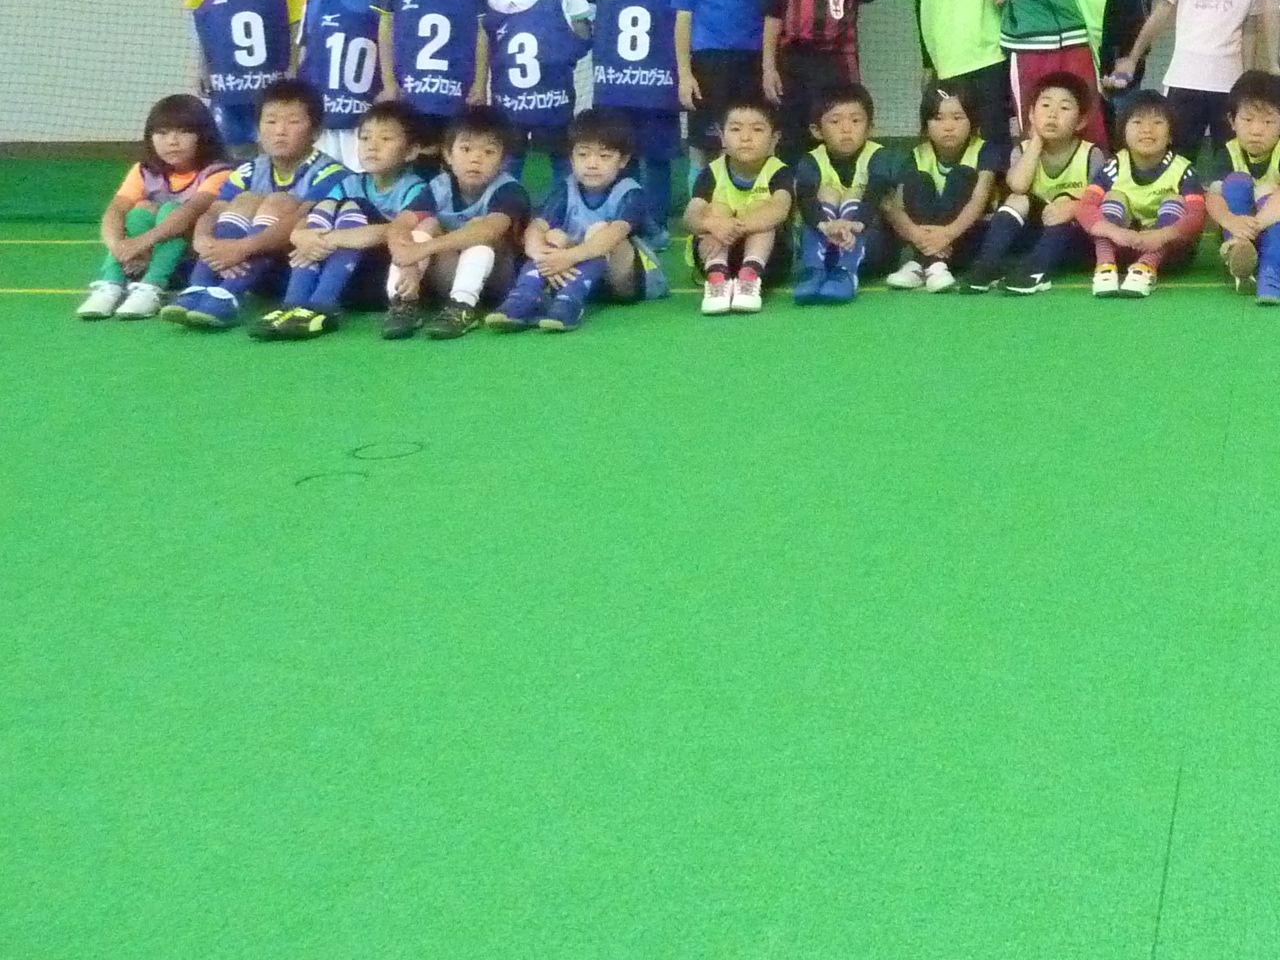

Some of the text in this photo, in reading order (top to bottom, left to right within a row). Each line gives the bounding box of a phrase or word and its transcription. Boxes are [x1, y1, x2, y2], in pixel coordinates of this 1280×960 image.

[231, 11, 267, 67] 9
[416, 13, 451, 71] 2
[508, 32, 541, 88] 3
[617, 6, 651, 61] 8
[326, 32, 377, 94] 10
